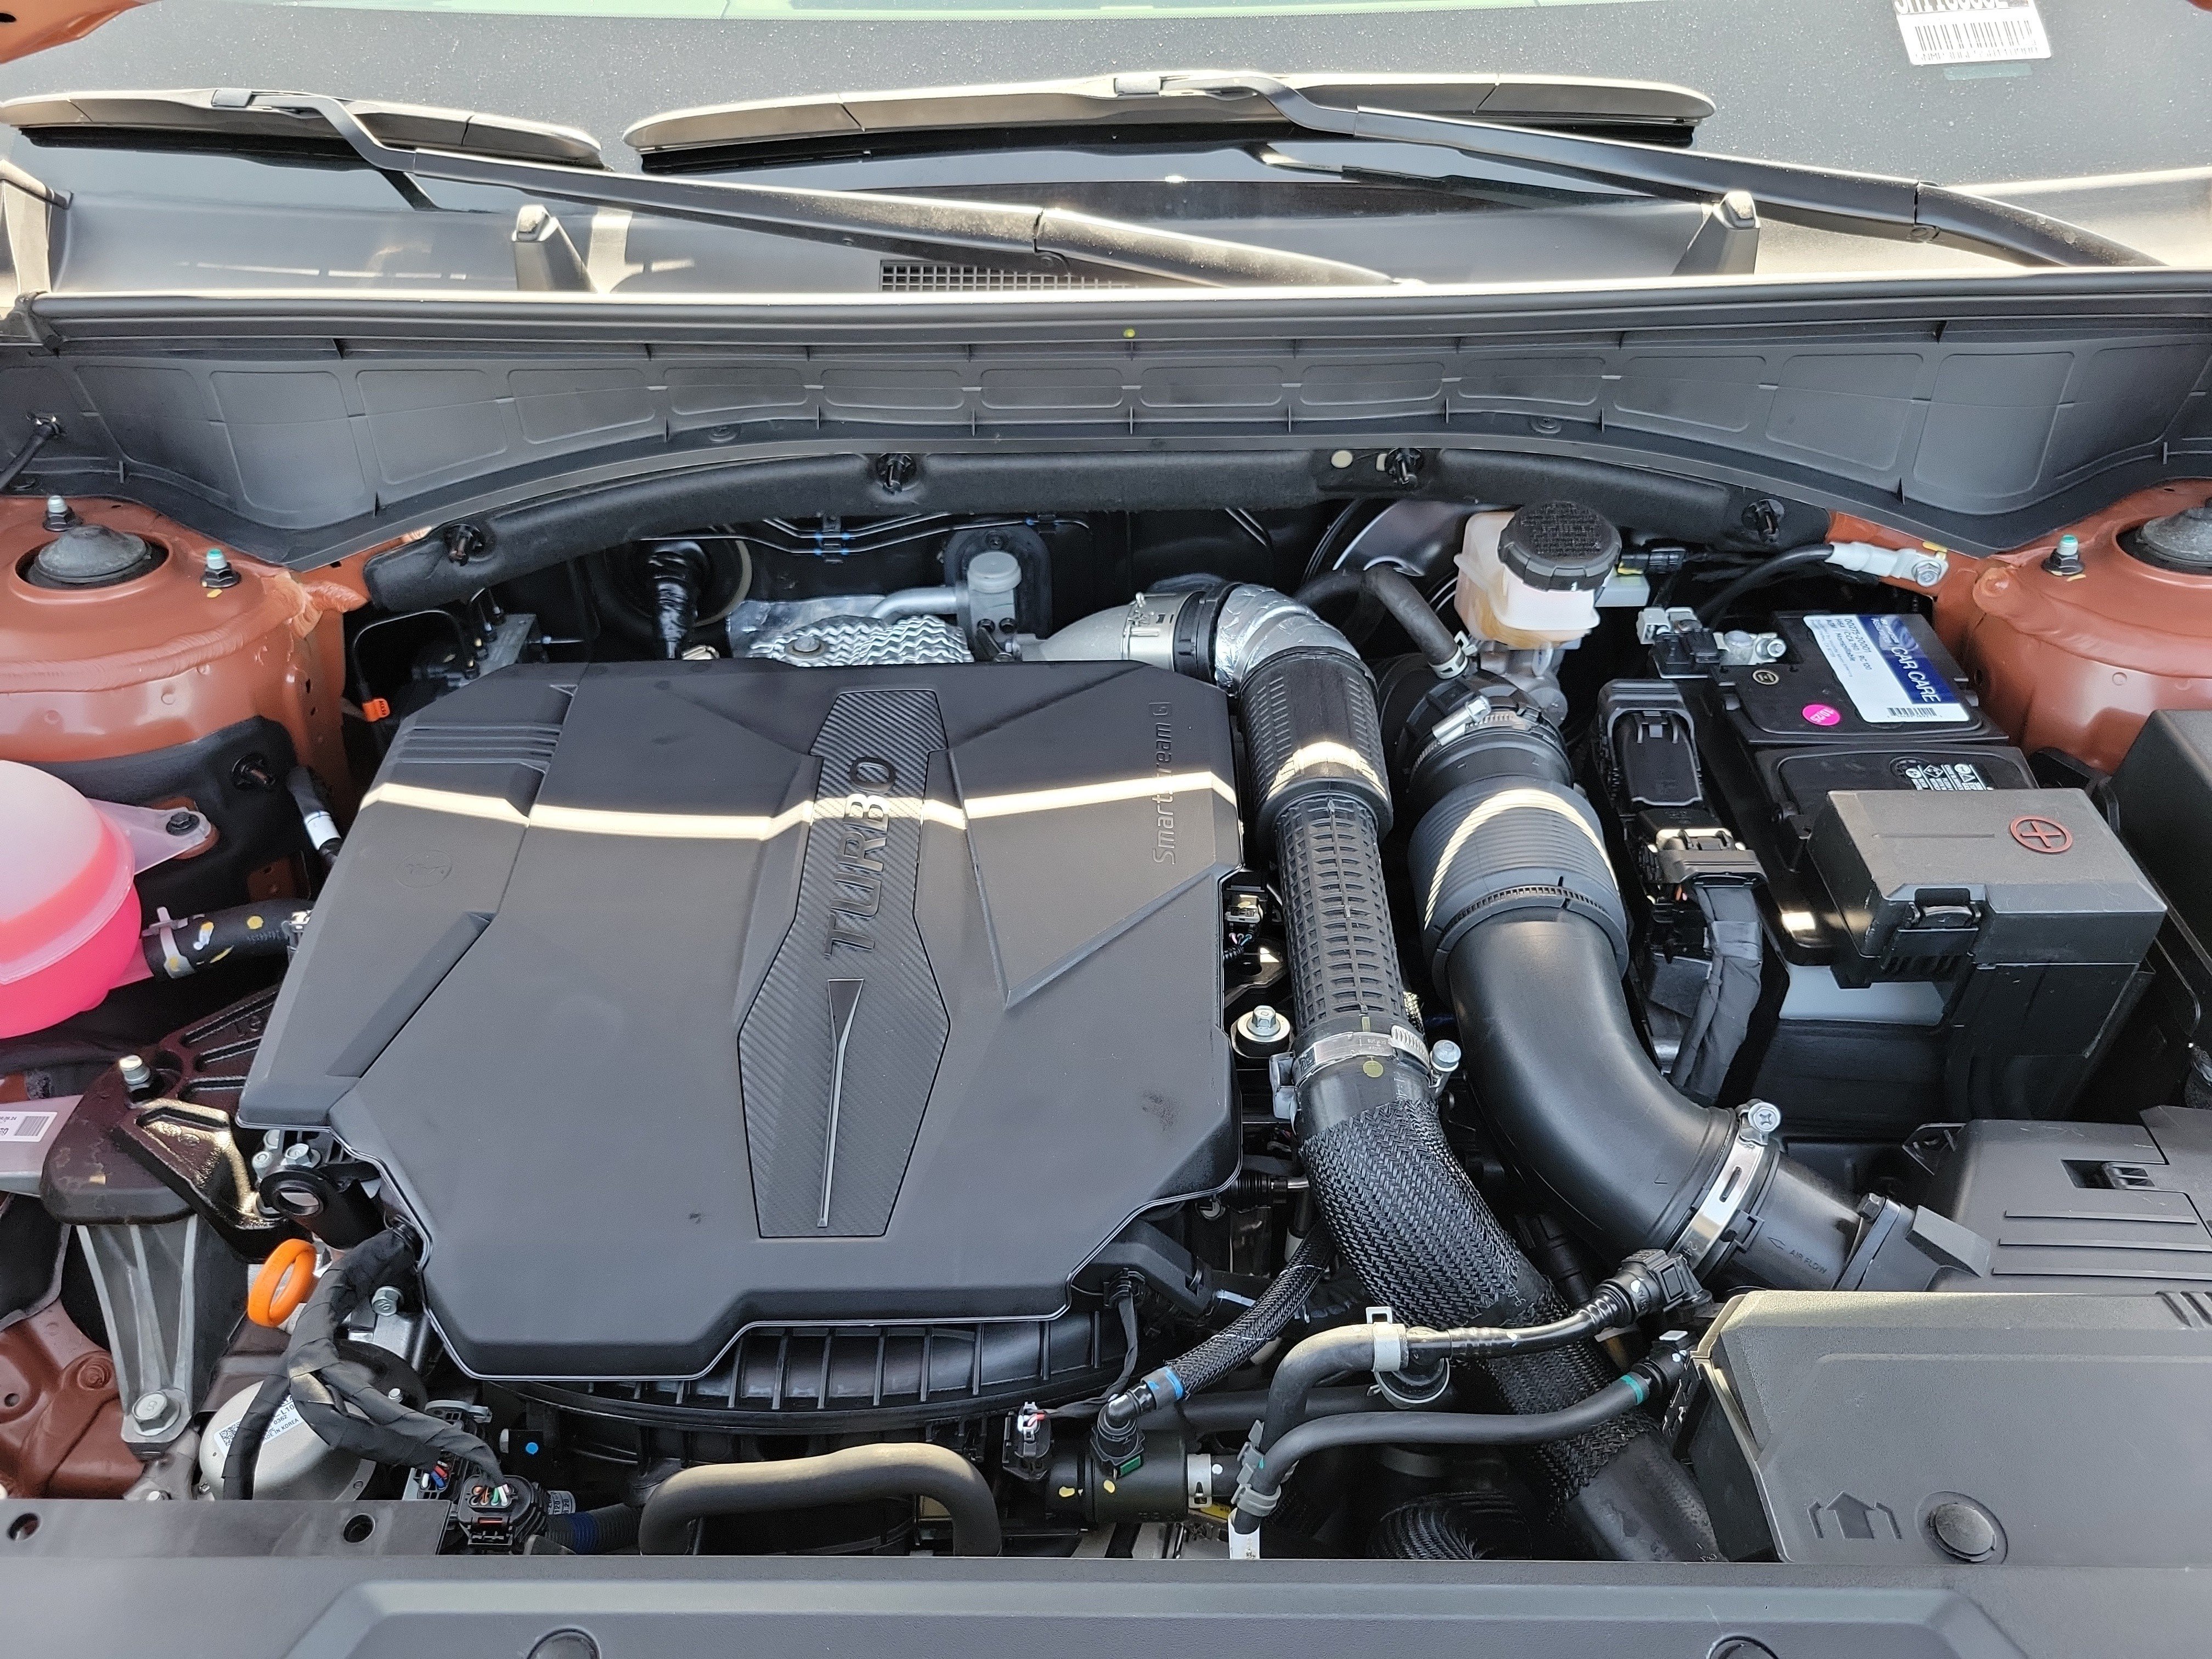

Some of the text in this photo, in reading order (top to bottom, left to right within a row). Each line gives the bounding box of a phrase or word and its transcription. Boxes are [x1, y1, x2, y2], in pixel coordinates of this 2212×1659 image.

[1891, 647, 1918, 669] CAR
[1908, 672, 1942, 703] CARE
[1152, 723, 1176, 865] Smartream
[823, 757, 896, 959] TURBO
[274, 1415, 287, 1425] 0362
[281, 1419, 299, 1430] KOREA
